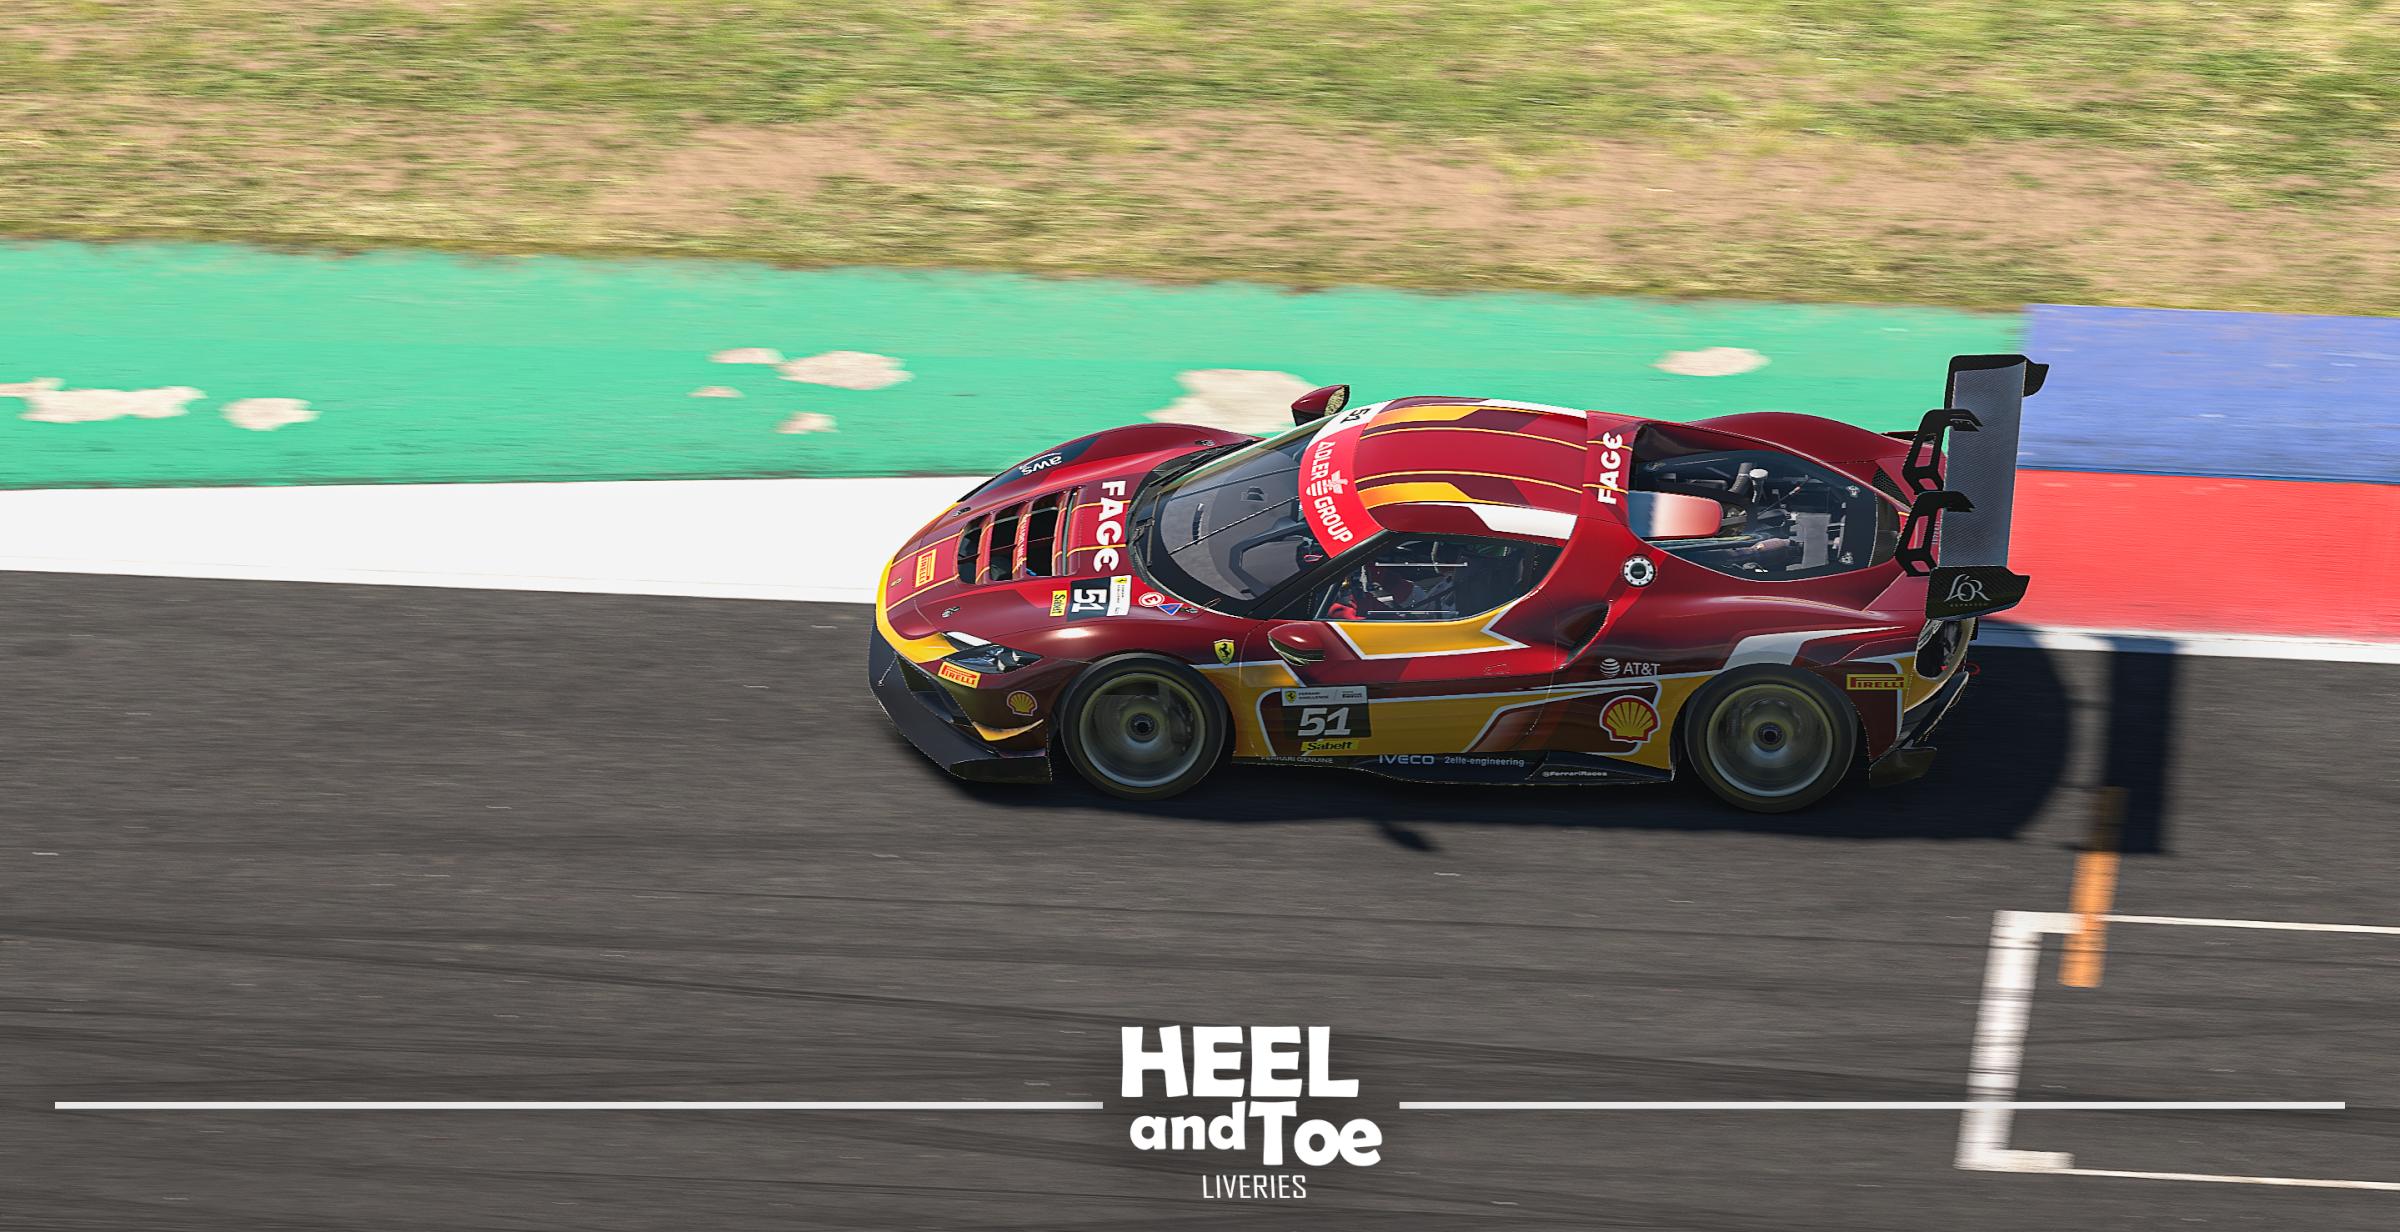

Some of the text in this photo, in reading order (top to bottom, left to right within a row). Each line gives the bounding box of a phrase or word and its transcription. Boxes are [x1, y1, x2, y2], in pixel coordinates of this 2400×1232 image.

[1340, 408, 1371, 424] 51
[1020, 455, 1062, 476] aws
[1597, 431, 1623, 505] FAGE
[1311, 441, 1353, 543] ADLER GROUP
[1093, 480, 1126, 572] FAGE
[1071, 588, 1107, 613] 51
[941, 664, 977, 685] PIRELLI
[1623, 662, 1661, 675] AT&T
[1850, 676, 1905, 688] PIRELLI
[1297, 706, 1351, 736] 51
[1307, 741, 1352, 751] Sabelt
[1379, 755, 1435, 765] IVECO
